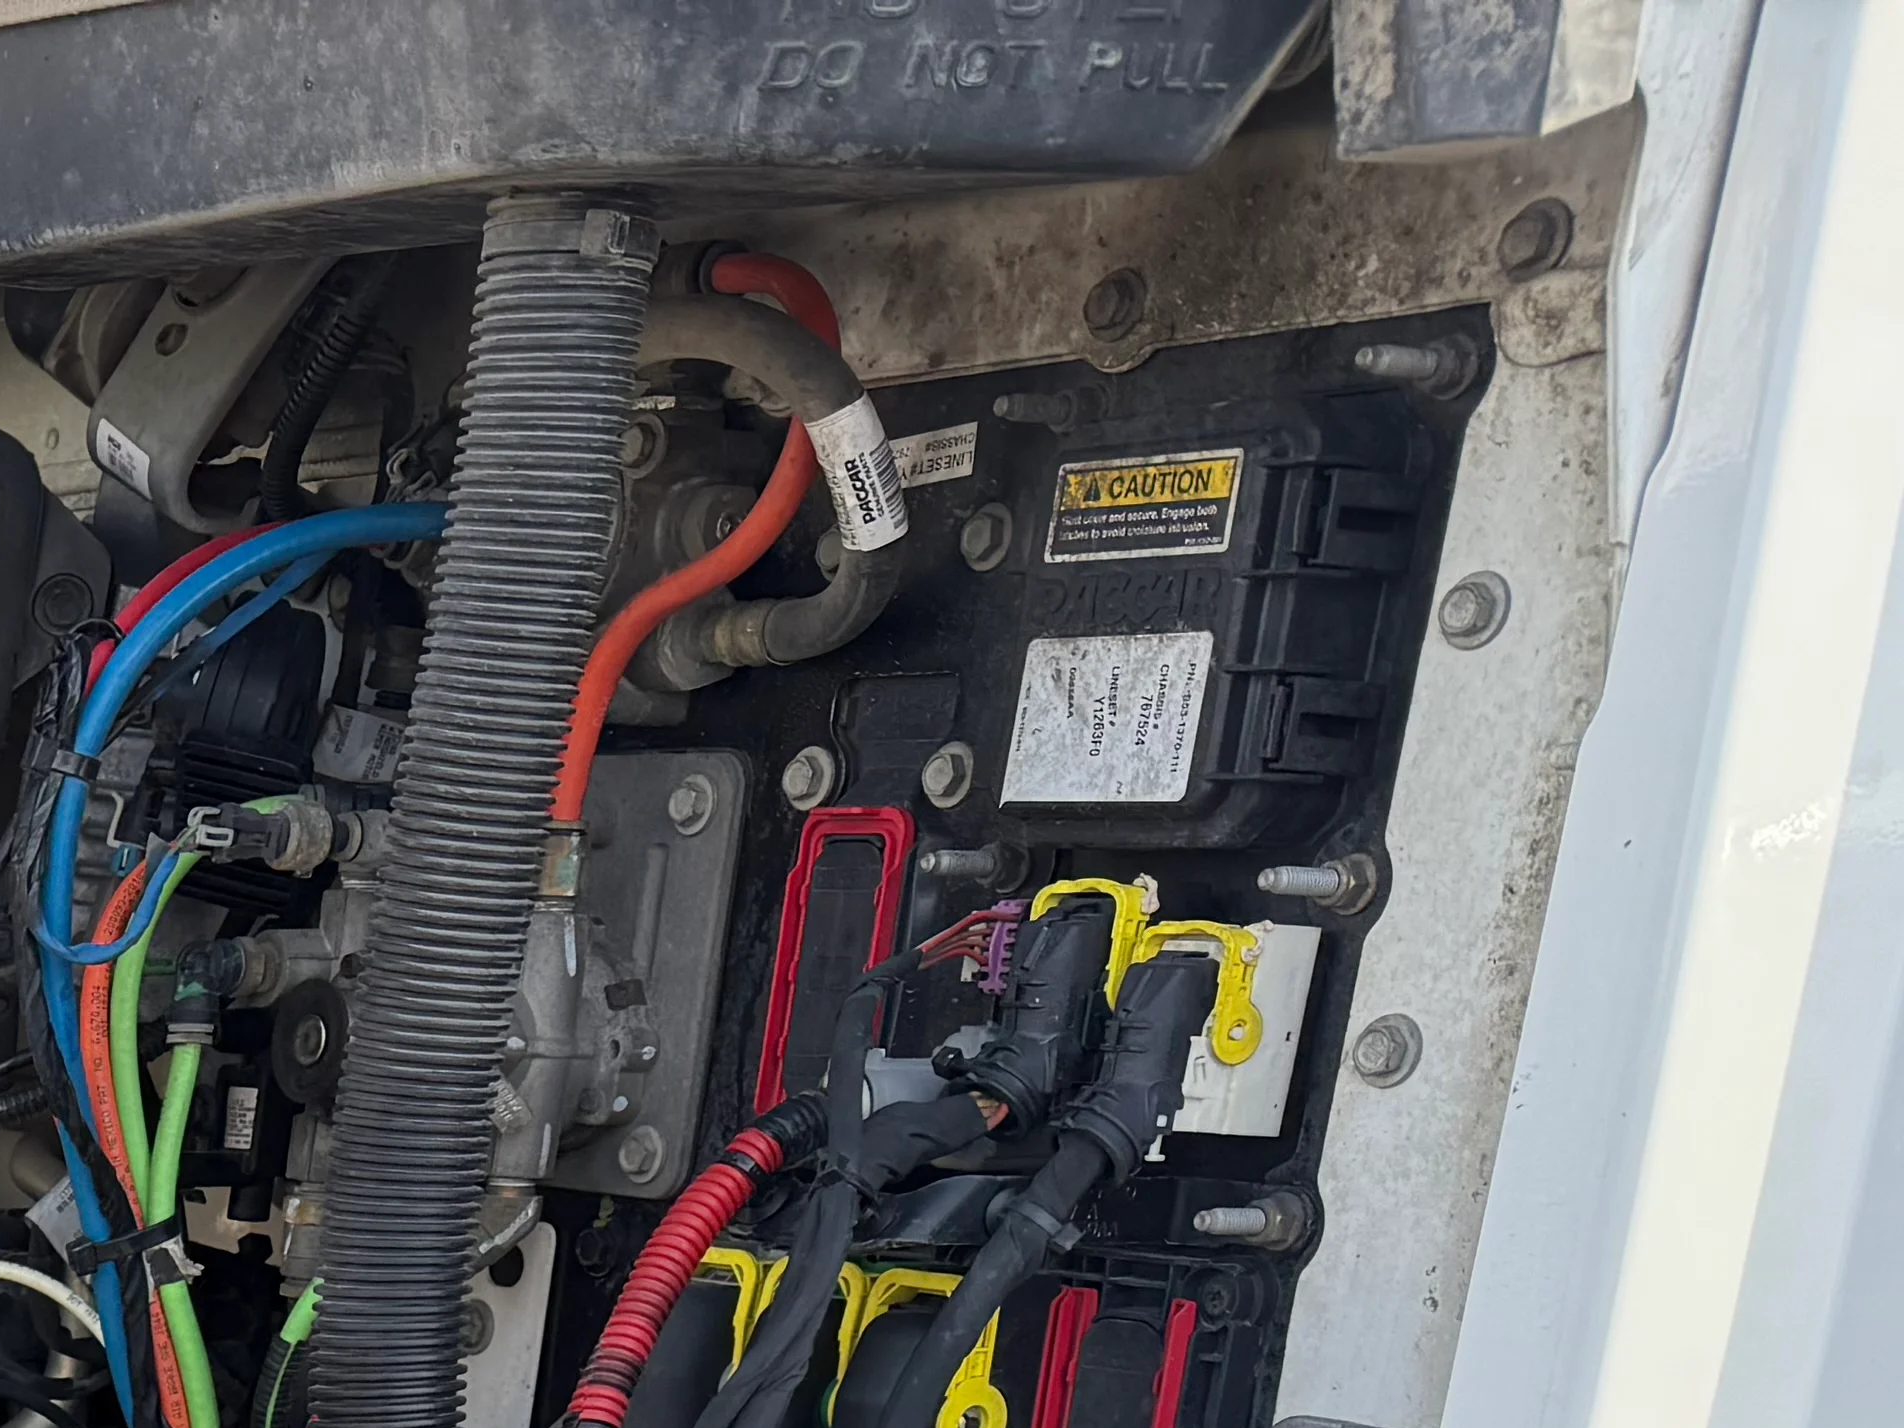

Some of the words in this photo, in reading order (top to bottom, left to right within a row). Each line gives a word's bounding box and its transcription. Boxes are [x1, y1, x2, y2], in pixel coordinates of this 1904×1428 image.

[759, 42, 864, 89] DO
[903, 40, 1049, 90] NOT
[1077, 41, 1229, 93] PULL
[844, 458, 877, 525] PACCAR
[1109, 467, 1212, 500] CAUTION
[1161, 507, 1195, 521] Engage
